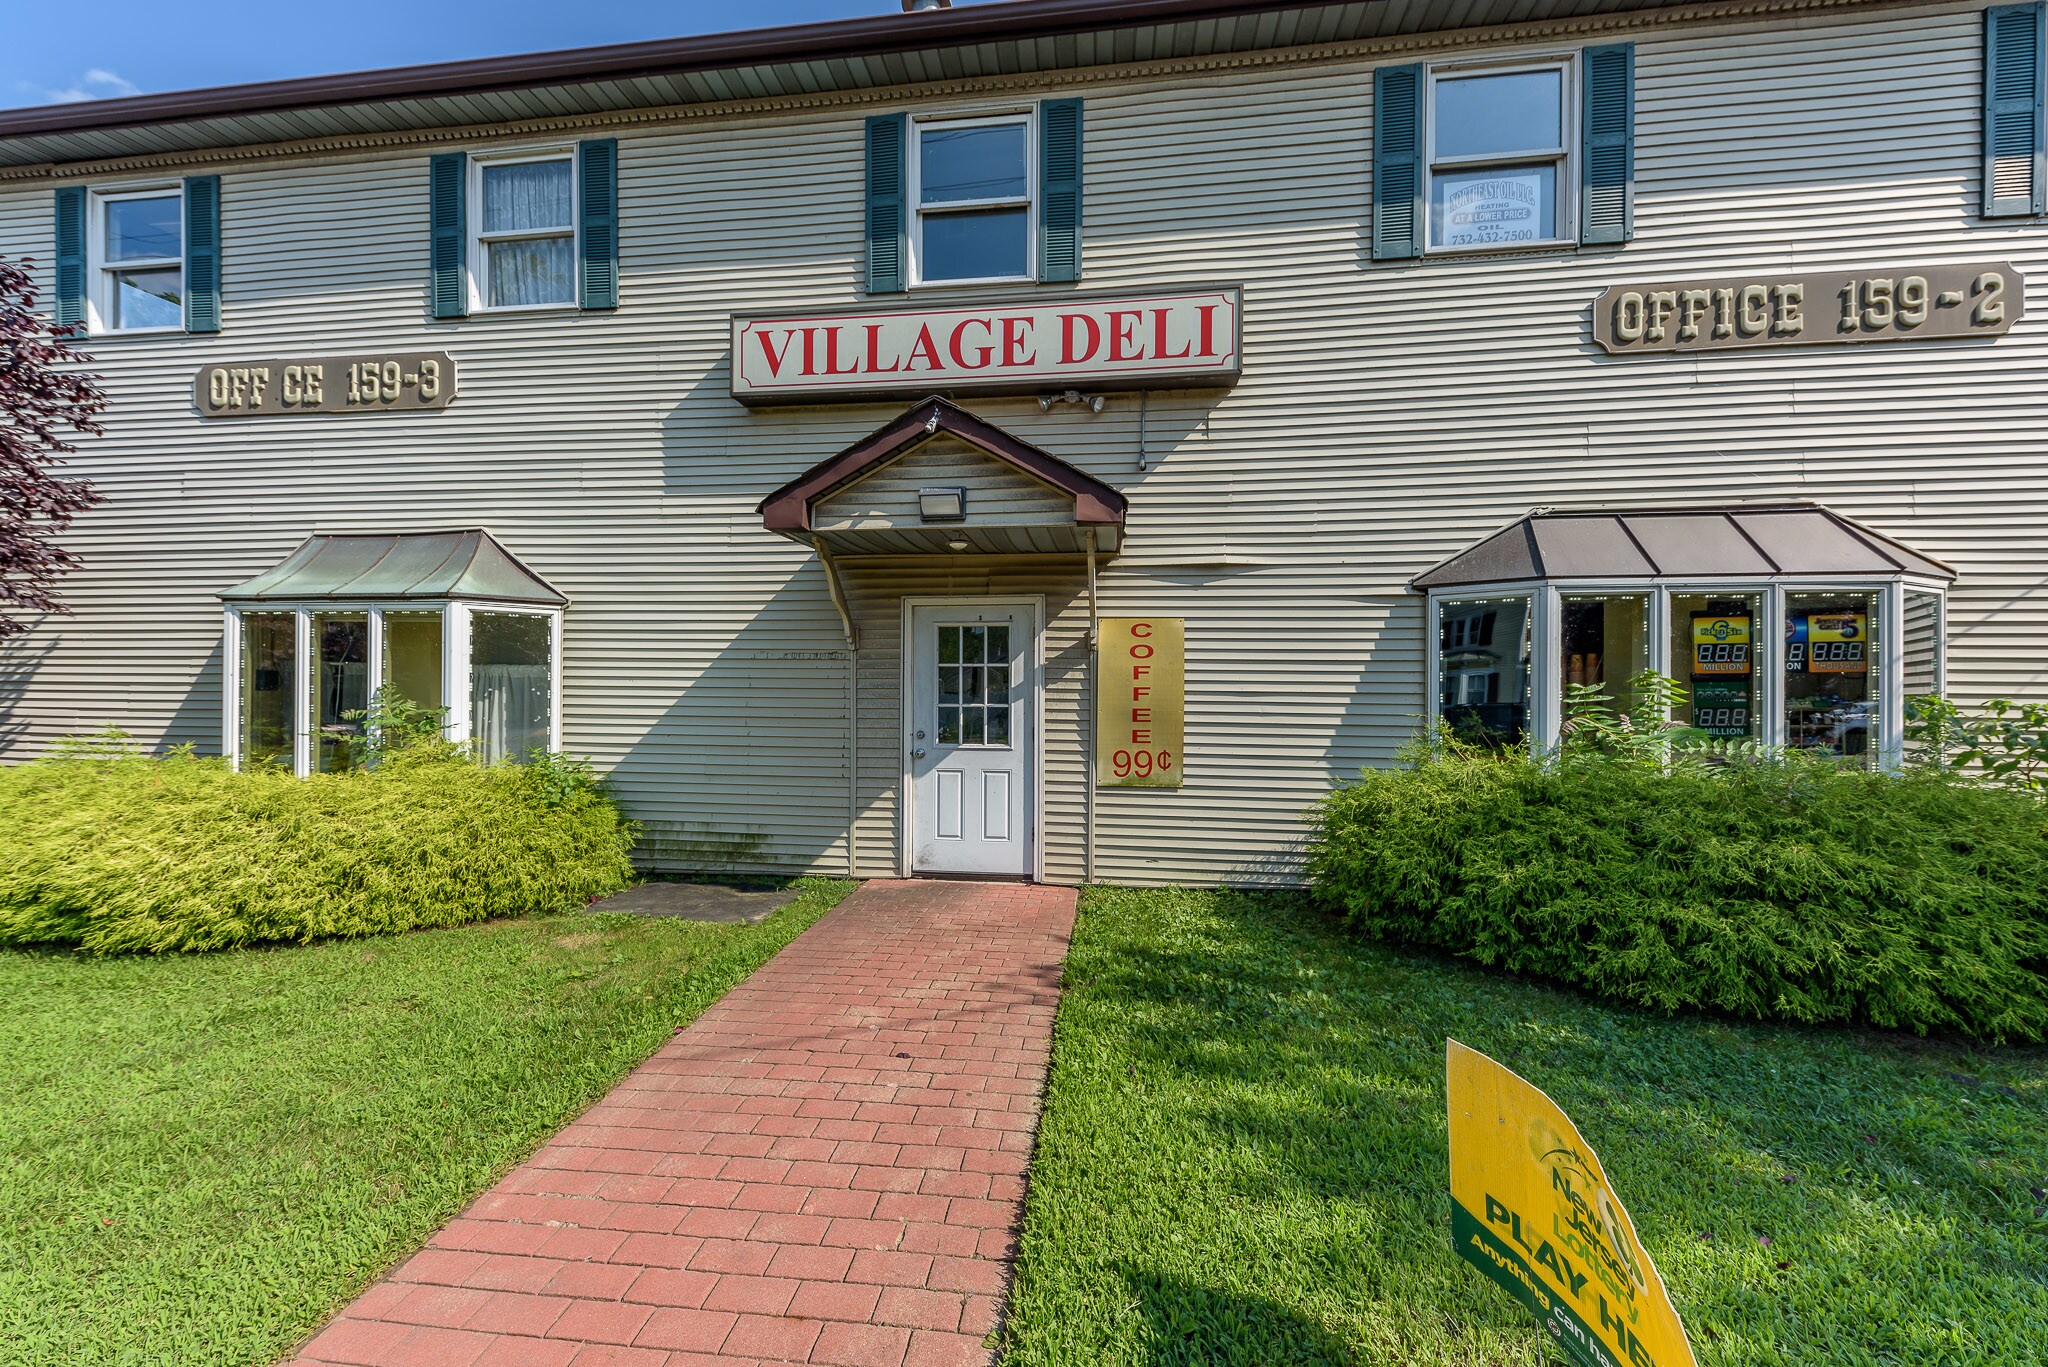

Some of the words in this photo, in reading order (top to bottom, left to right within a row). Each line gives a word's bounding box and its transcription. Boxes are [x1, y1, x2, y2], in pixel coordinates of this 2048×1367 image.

[1449, 181, 1499, 213] NORTHEAST
[1500, 181, 1515, 200] OIL
[1455, 214, 1467, 224] AT
[1467, 214, 1475, 223] A
[1475, 211, 1502, 222] LOWER
[1504, 209, 1528, 219] PRICE
[1475, 202, 1510, 210] HEATING
[1452, 229, 1533, 245] 732-432-7500
[1615, 282, 1804, 342] OFFICE
[1840, 272, 2005, 331] 159-2
[754, 316, 1037, 379] VILLAGE
[1056, 304, 1220, 366] DELI
[347, 359, 440, 404] 159-3
[1129, 623, 1154, 744] COFFEE
[1703, 663, 1744, 671] MILLION
[1786, 662, 1802, 670] ON
[1704, 727, 1744, 735] MILLION
[1552, 1166, 1603, 1236] New
[1485, 1192, 1589, 1300] PLAY
[1599, 1293, 1656, 1367] HE
[1553, 1212, 1639, 1325] Lottery
[1565, 1207, 1635, 1302] Jersey
[1470, 1233, 1550, 1311] Anything
[1553, 1306, 1585, 1345] can
[1589, 1336, 1614, 1367] ha
